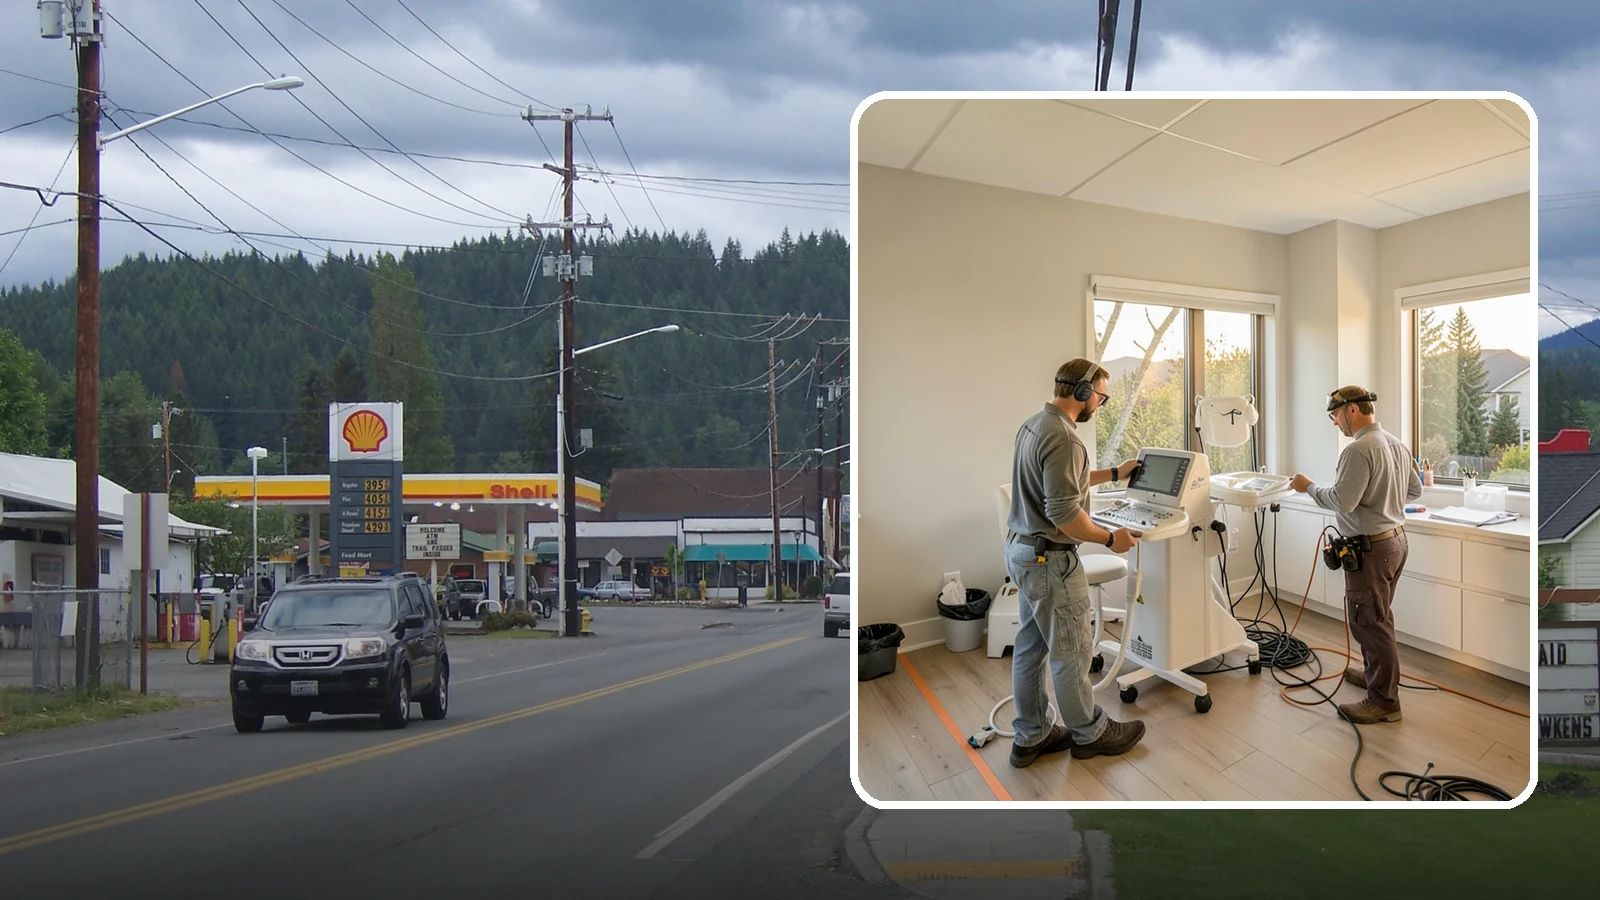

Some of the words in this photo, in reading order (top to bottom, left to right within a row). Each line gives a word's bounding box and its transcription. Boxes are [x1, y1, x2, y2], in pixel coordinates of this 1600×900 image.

[366, 480, 383, 490] 395
[490, 484, 547, 499] Shell
[366, 494, 383, 504] 405
[366, 508, 383, 518] 415
[366, 522, 383, 532] 429
[1538, 643, 1567, 665] AID
[1538, 716, 1592, 739] WKENS
